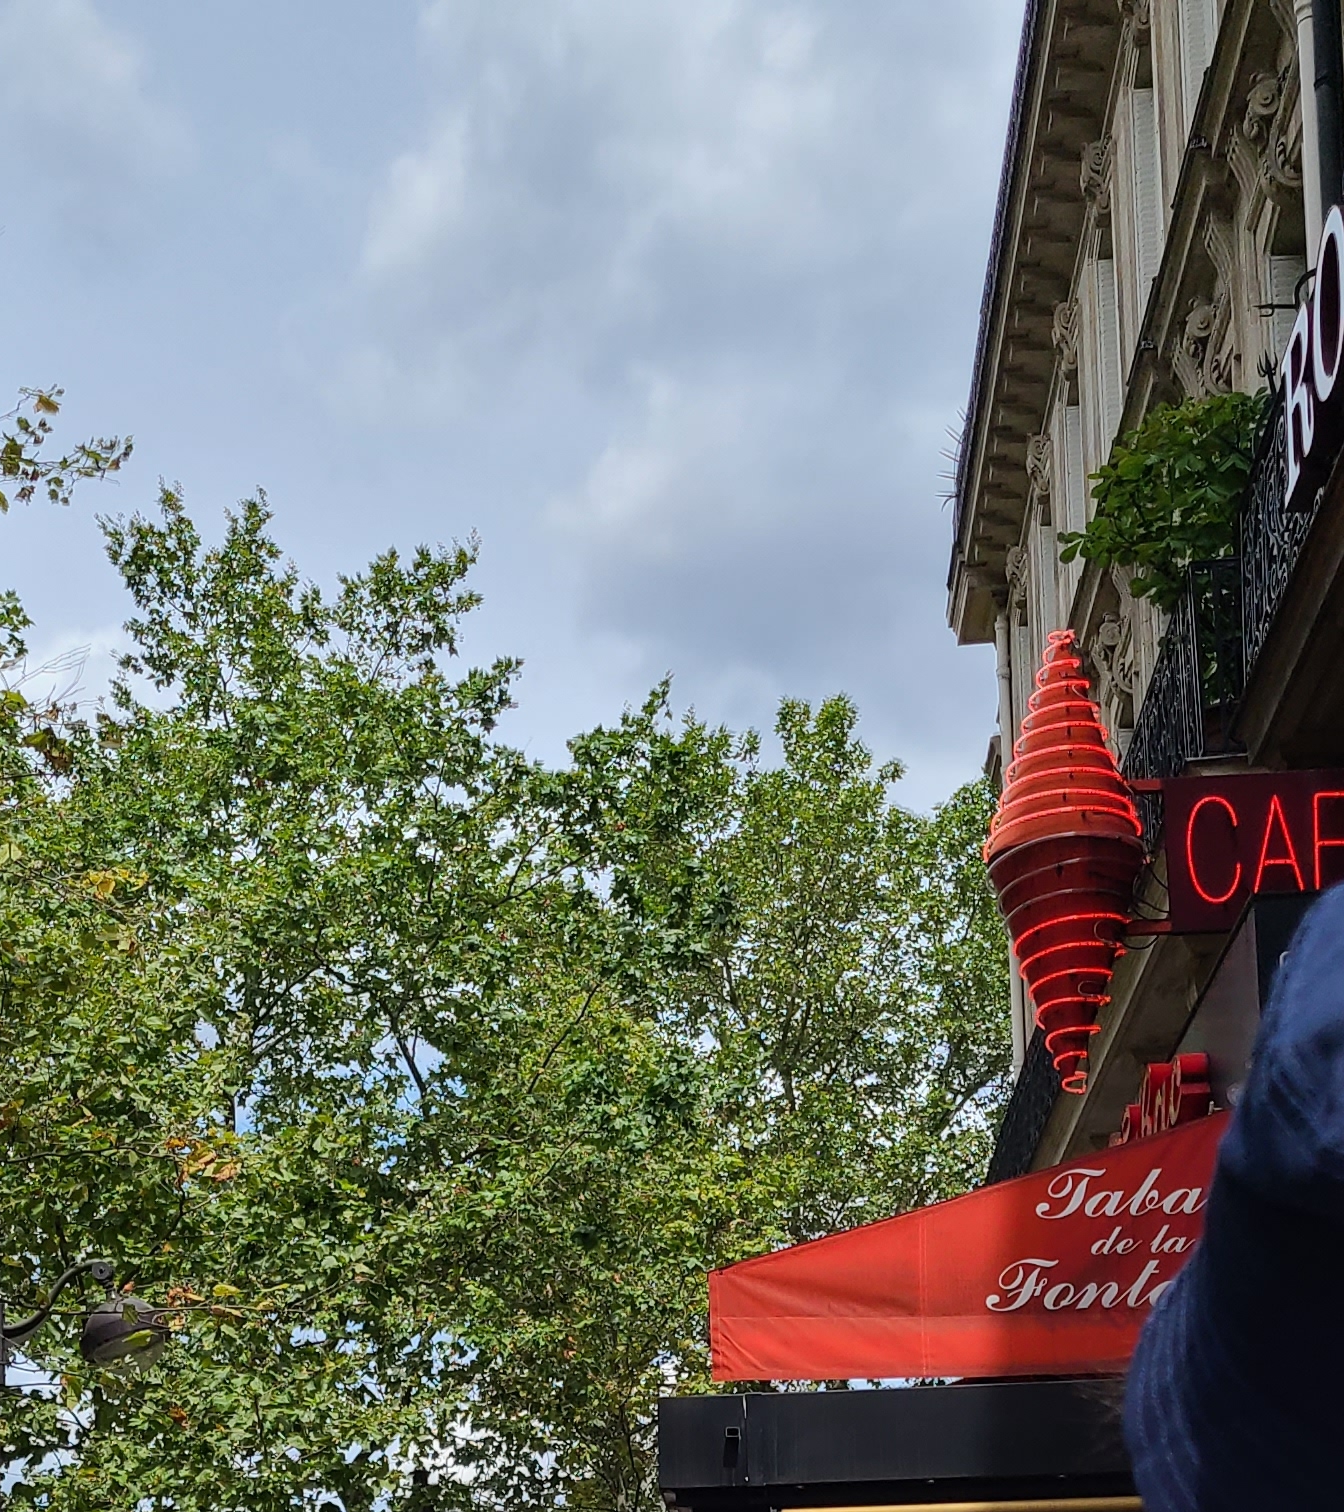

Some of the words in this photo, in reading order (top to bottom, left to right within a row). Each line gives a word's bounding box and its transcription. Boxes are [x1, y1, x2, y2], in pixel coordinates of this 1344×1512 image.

[1035, 1167, 1208, 1219] Taba
[1090, 1226, 1143, 1255] de
[1150, 1224, 1196, 1253] la
